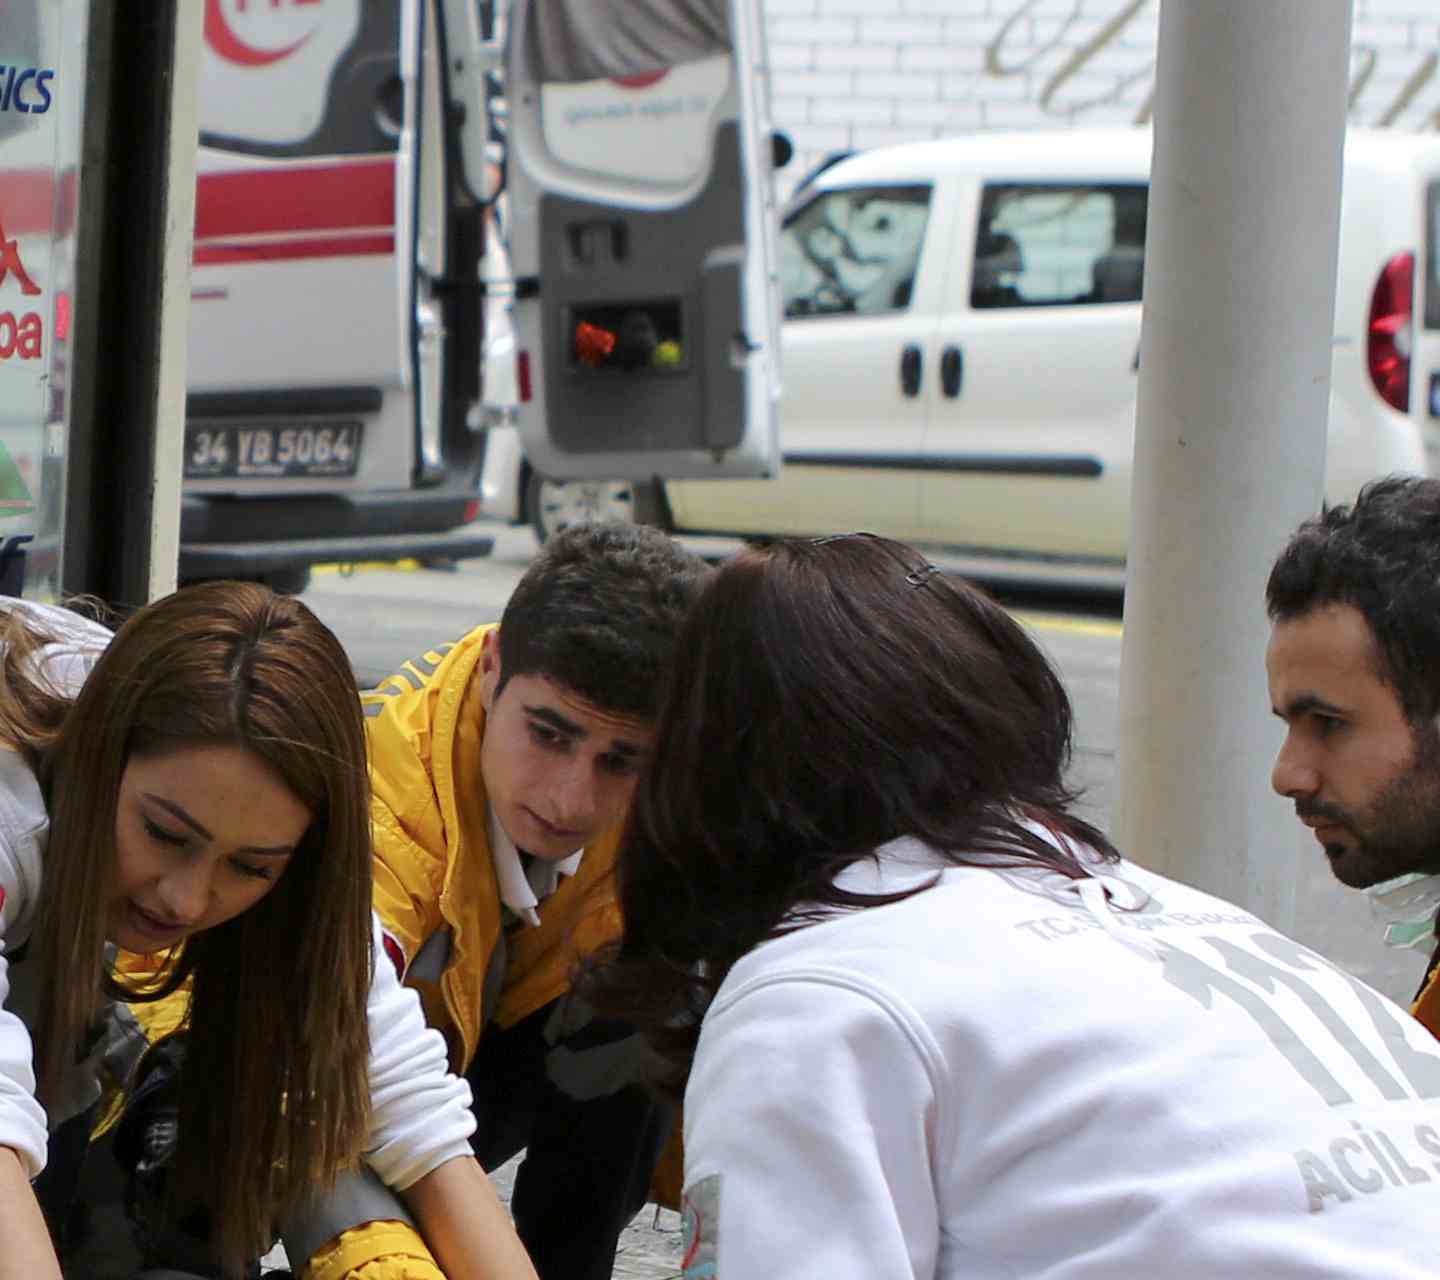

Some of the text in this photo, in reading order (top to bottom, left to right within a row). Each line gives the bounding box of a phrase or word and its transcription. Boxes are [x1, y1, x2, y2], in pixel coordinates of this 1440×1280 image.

[192, 431, 228, 464] 34
[277, 428, 354, 465] 5064
[1292, 1119, 1431, 1214] ACİL
